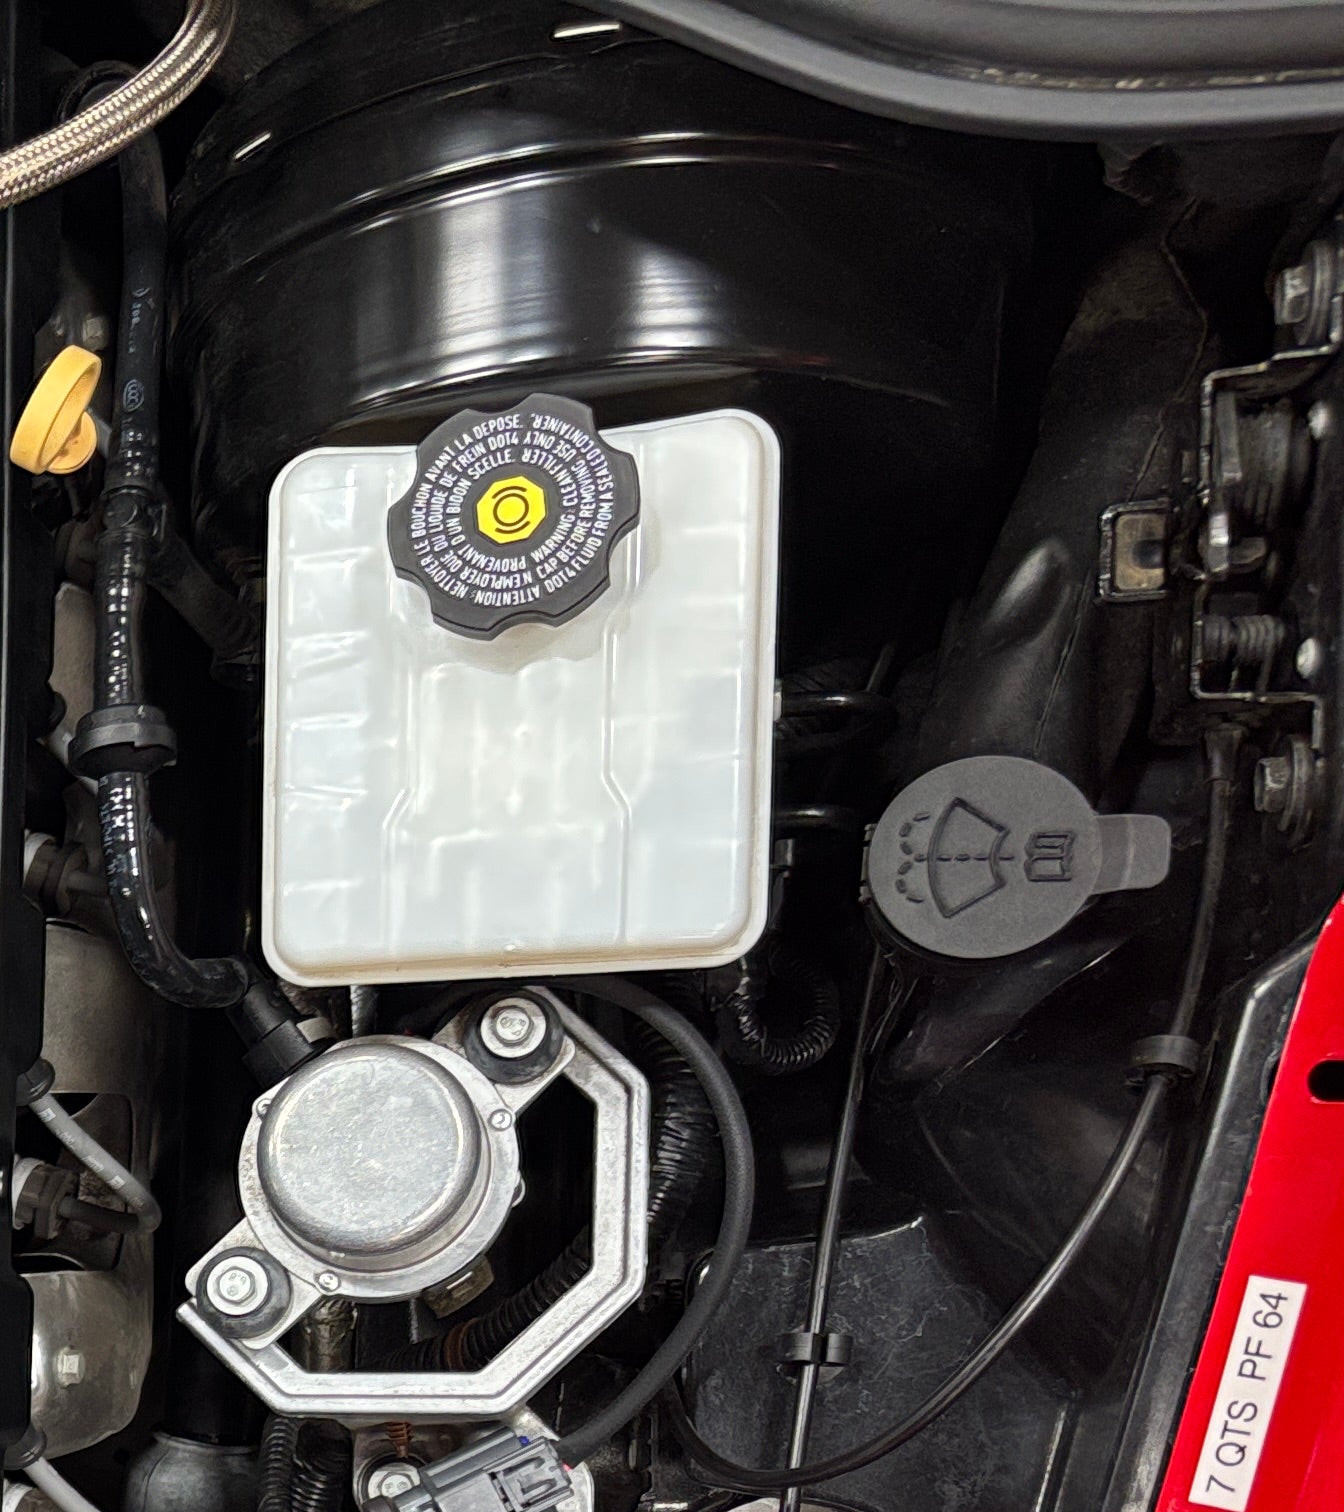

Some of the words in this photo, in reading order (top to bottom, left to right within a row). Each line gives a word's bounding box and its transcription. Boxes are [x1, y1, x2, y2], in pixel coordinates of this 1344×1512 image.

[454, 431, 473, 450] LA
[524, 430, 555, 450] ONLY
[557, 439, 578, 462] USE
[424, 446, 456, 481] AVANT
[452, 443, 486, 473] FREIN
[521, 448, 563, 480] FILLER
[586, 452, 614, 491] SEALED
[439, 468, 458, 488] DE
[555, 469, 578, 507] CLEAN
[410, 483, 433, 539] BOUCHON
[428, 487, 448, 534] LIQUIDE
[446, 478, 472, 514] BIDON
[605, 491, 614, 500] A
[593, 501, 613, 537] FROM
[414, 539, 428, 556] LE
[431, 534, 449, 551] DU
[458, 542, 526, 573] PROVENANT
[557, 518, 593, 564] BEFORE
[572, 537, 602, 572] FLUID
[421, 558, 468, 598] NETTOYER
[439, 549, 462, 574] QUE
[536, 560, 558, 579] CAP
[1253, 1291, 1289, 1329] 64
[1237, 1336, 1273, 1381] PF
[1215, 1399, 1258, 1467] QTS
[1206, 1473, 1237, 1496] 7
